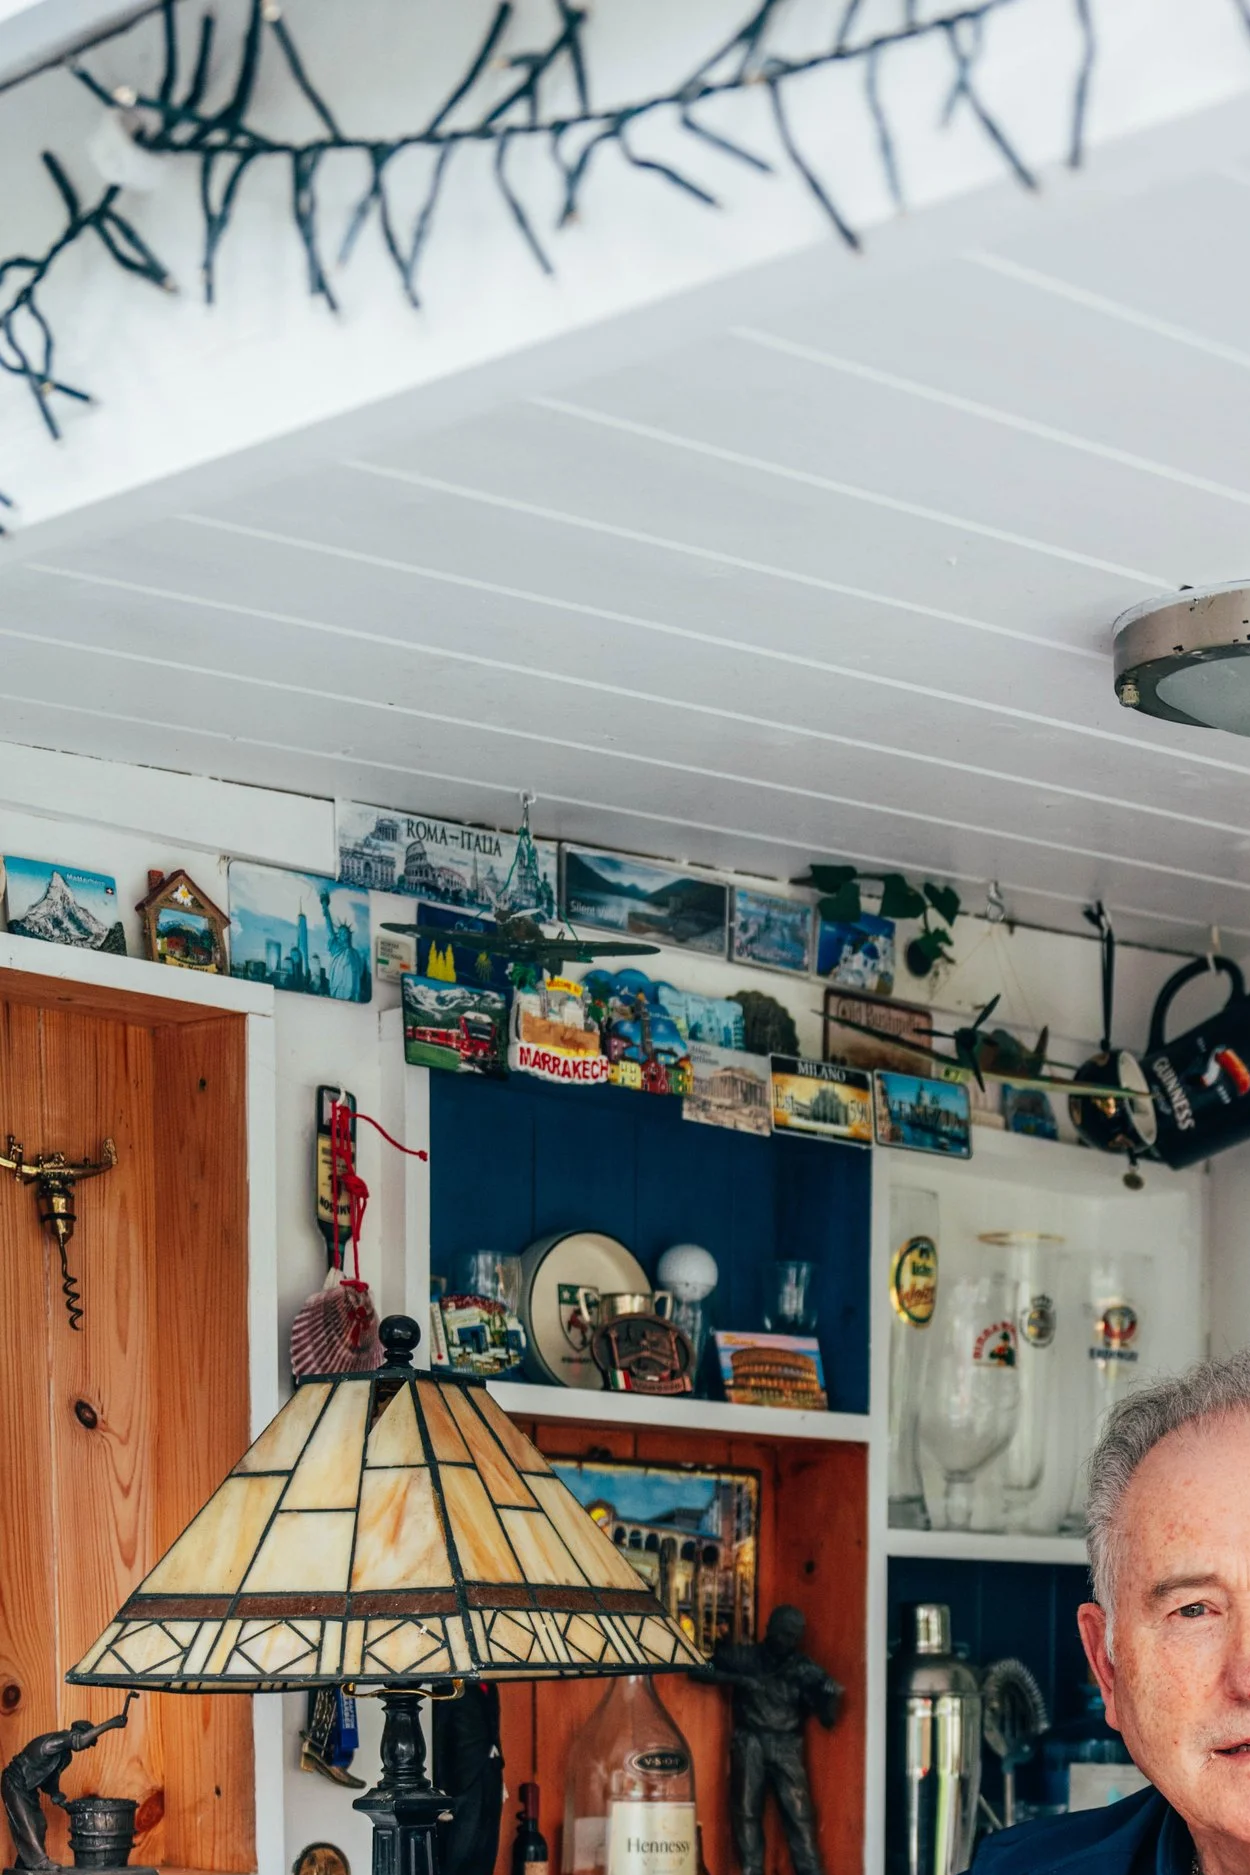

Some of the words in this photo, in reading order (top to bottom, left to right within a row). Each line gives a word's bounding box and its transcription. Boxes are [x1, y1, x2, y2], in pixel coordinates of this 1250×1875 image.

[519, 1046, 609, 1080] MARRAKECH
[797, 1061, 847, 1083] MILANO
[1153, 1056, 1195, 1131] GUINNESS
[627, 1837, 690, 1857] Hennessy
